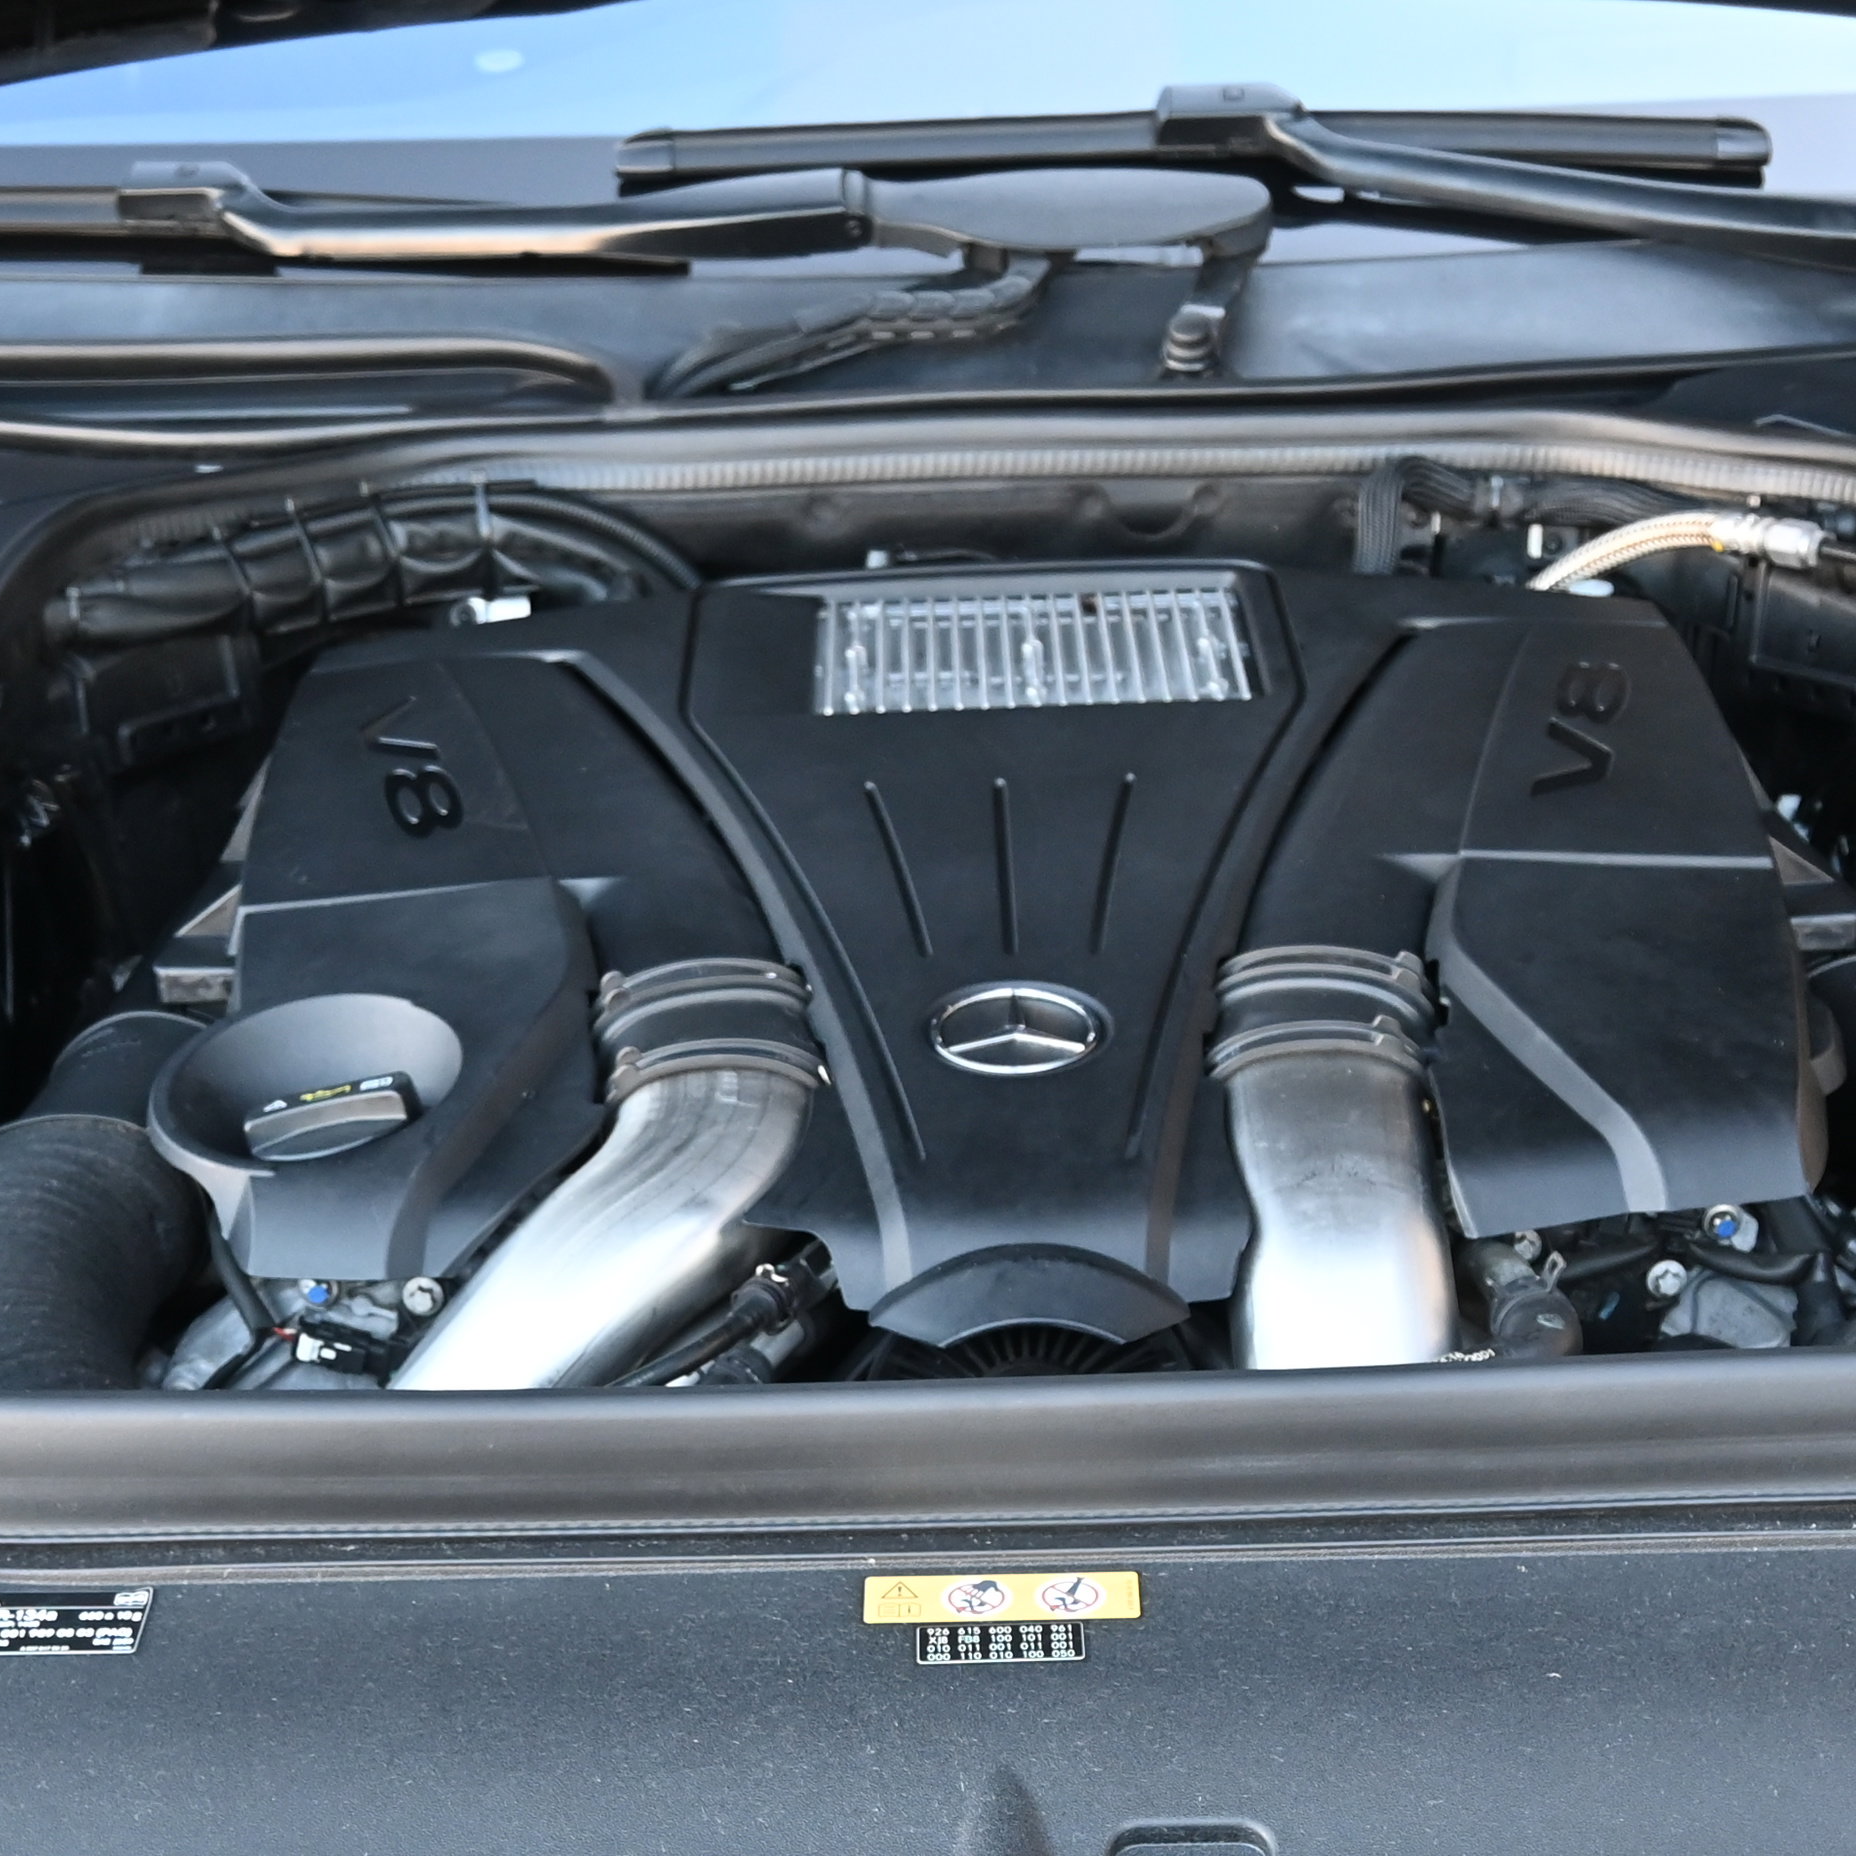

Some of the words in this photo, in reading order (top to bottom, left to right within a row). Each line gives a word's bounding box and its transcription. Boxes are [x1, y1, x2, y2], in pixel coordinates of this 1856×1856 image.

[1529, 660, 1632, 797] V8
[357, 694, 465, 839] V8
[927, 1628, 950, 1636] 926
[989, 1626, 1012, 1634] 600
[1019, 1625, 1043, 1633] 040
[1050, 1624, 1072, 1632] 961
[958, 1644, 980, 1652] 011
[989, 1643, 1011, 1651] 001
[1020, 1642, 1042, 1650] 011
[1051, 1641, 1073, 1649] 001
[927, 1653, 950, 1661] 000
[960, 1652, 982, 1660] 110
[989, 1651, 1013, 1659] 010
[1052, 1650, 1075, 1658] 050
